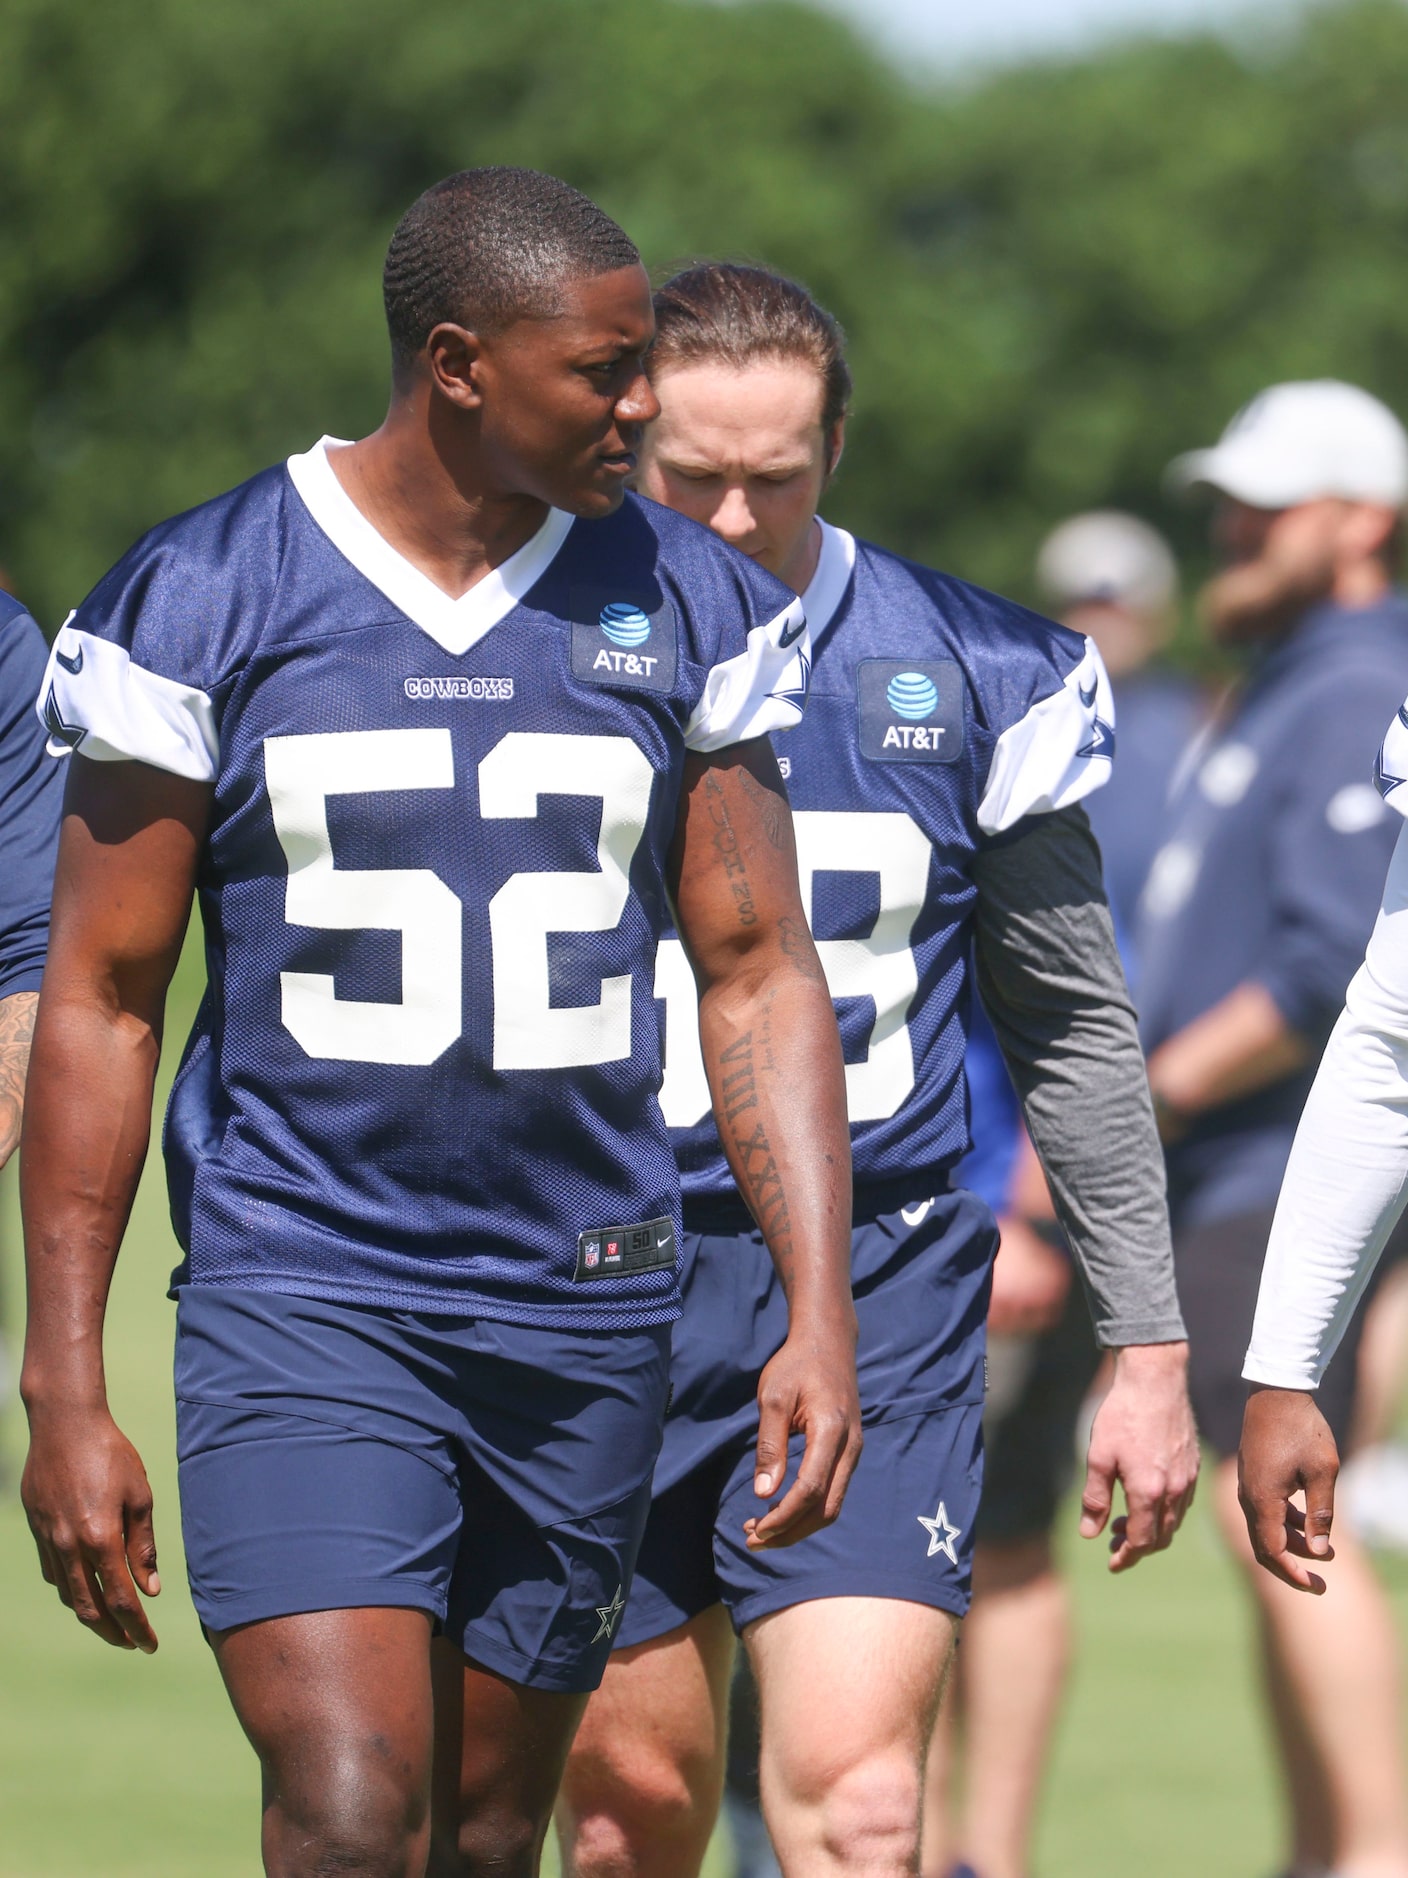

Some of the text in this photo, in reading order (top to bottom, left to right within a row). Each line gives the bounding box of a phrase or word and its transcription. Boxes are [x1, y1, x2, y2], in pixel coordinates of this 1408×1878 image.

[593, 649, 658, 676] AT&T
[404, 677, 514, 699] COWBOYS
[882, 726, 945, 750] AT&T
[263, 728, 655, 1070] 52
